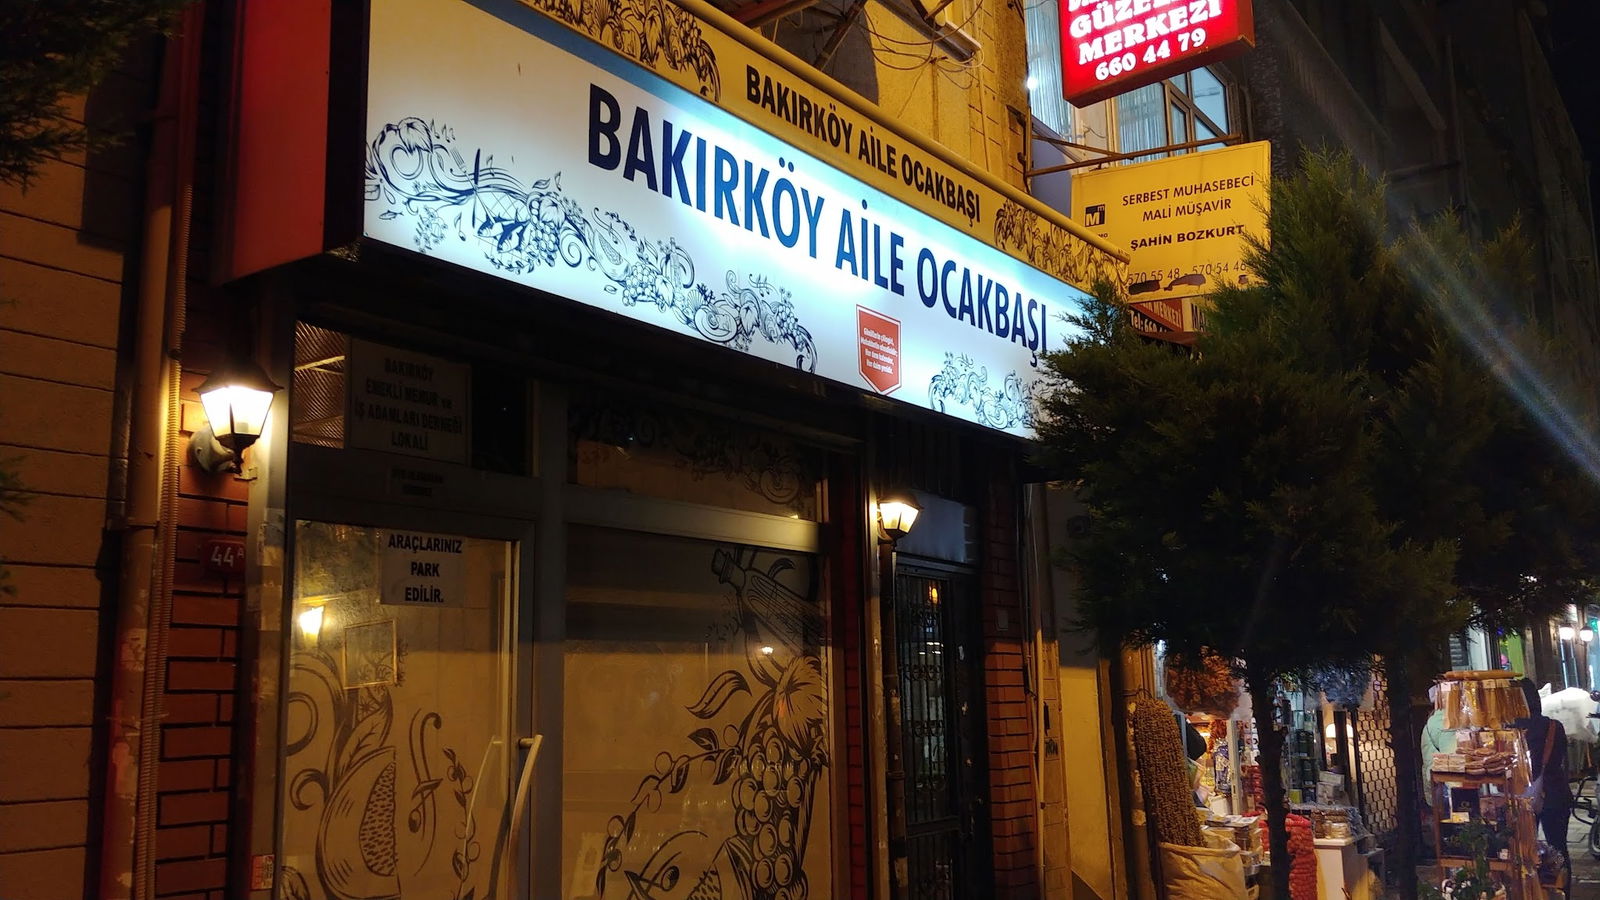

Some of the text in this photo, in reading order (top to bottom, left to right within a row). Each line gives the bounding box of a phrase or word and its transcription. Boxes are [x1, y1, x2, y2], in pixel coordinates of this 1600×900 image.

[1095, 27, 1206, 81] 660 44 79
[747, 64, 981, 227] BAKIRKÖY AİLE OCAKBAŞI
[1122, 172, 1254, 206] SERBEST MUHASEBECİ
[1142, 196, 1232, 222] MALİ MÜŞAVİR
[588, 83, 1047, 367] BAKIRKÖY AİLE OCAKBAŞI
[1130, 224, 1244, 251] ŞAHİN BOZKURT
[1128, 271, 1147, 285] 570
[368, 403, 420, 427] ADAMLARI
[391, 431, 429, 451] LOKALİ
[388, 534, 463, 554] ARAÇLARINIZ
[410, 562, 440, 577] PARK
[405, 584, 444, 603] EDİLİR.
